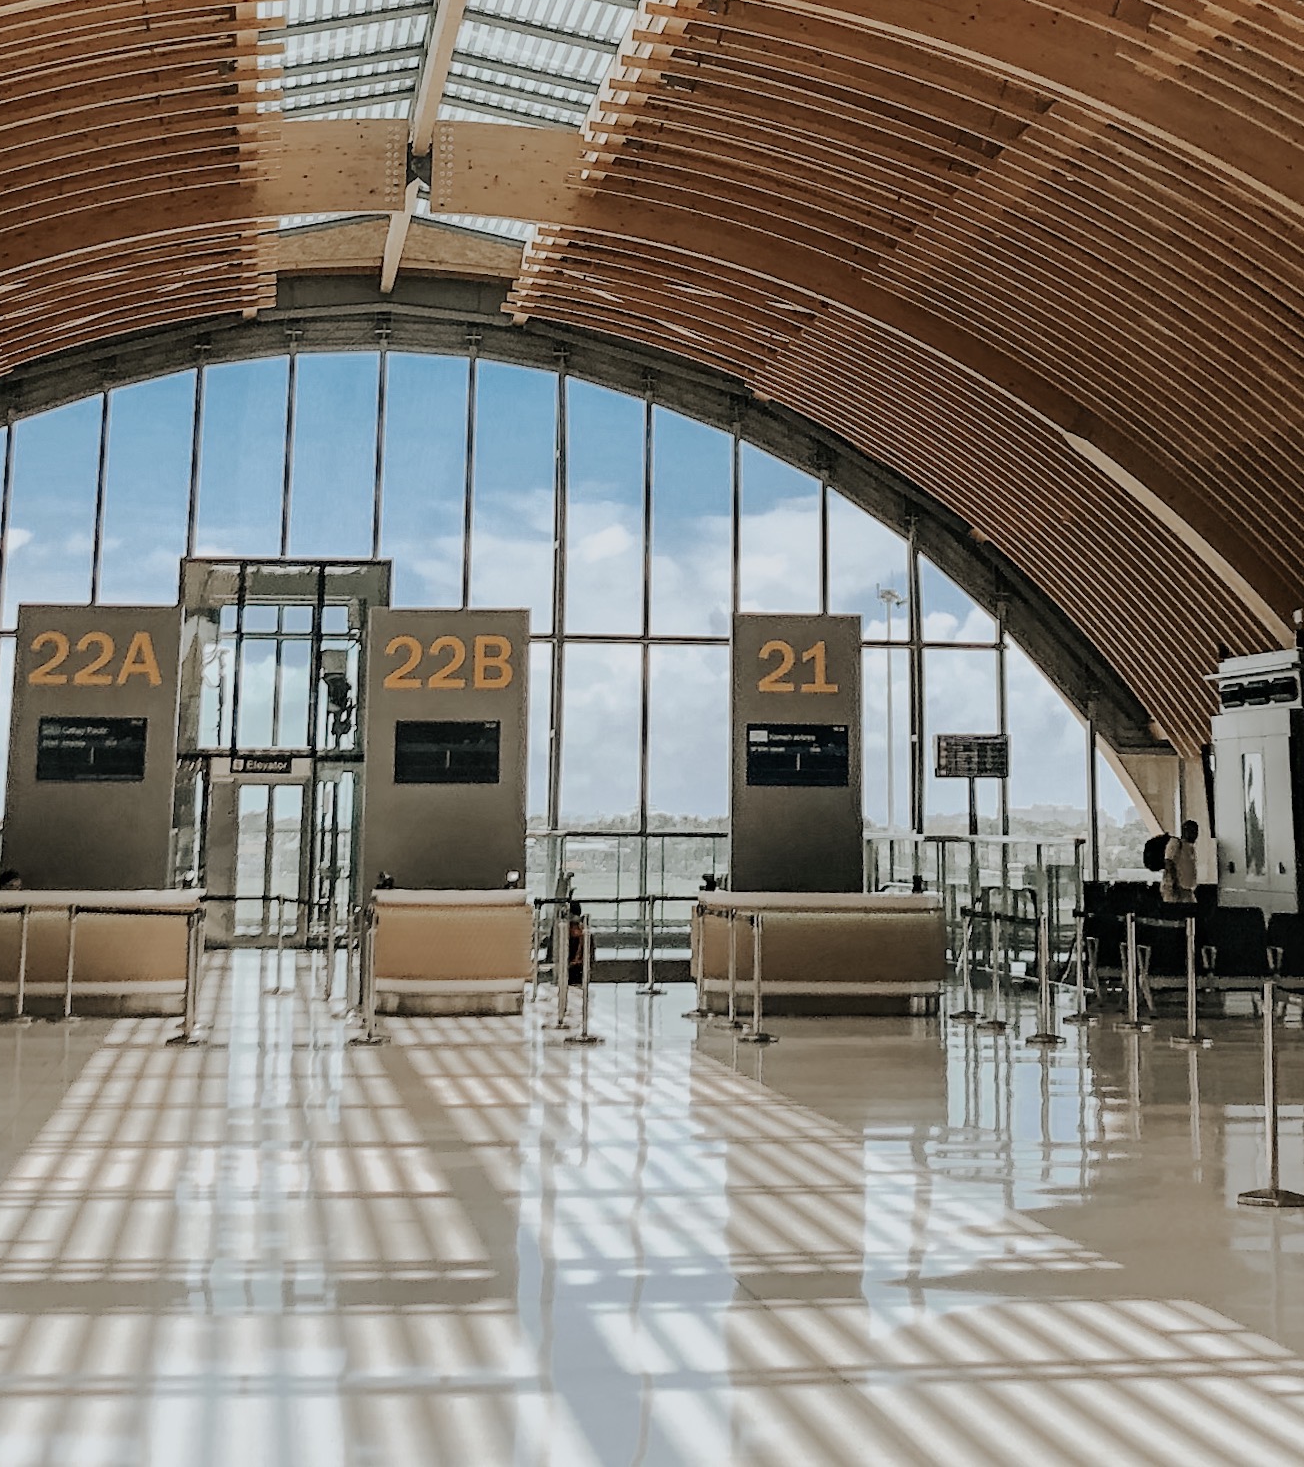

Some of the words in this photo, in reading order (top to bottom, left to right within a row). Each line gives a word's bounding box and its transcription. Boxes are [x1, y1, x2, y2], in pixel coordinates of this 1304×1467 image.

[28, 631, 163, 687] 22A
[382, 635, 514, 690] 22B
[757, 639, 839, 694] 21
